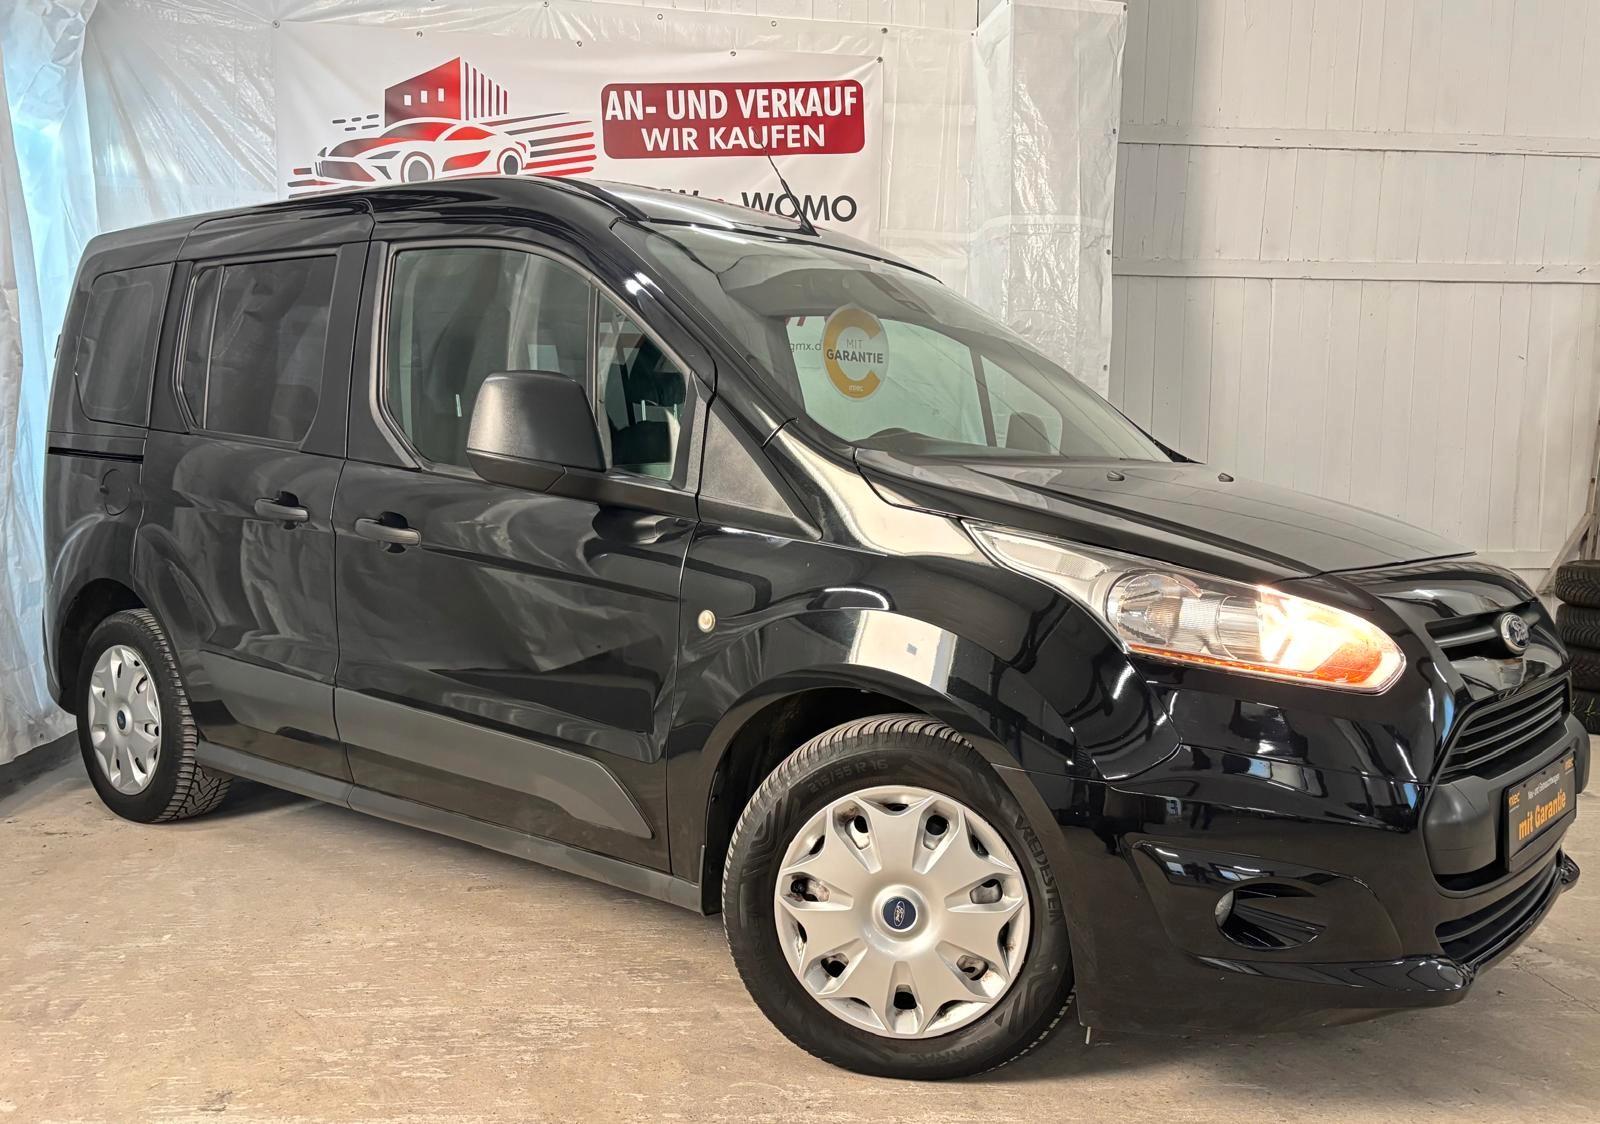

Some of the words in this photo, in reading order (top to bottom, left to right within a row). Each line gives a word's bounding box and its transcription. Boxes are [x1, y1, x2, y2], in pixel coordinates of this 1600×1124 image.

[605, 90, 657, 121] AN-
[666, 89, 729, 120] UND
[735, 86, 857, 119] VERKAUF
[641, 127, 699, 151] WIR
[709, 124, 825, 149] KAUFEN
[741, 191, 857, 222] WOMO
[826, 349, 884, 364] GARANTIE
[846, 339, 863, 350] MIT
[1518, 814, 1533, 840] mit
[1535, 789, 1566, 826] Garantie
